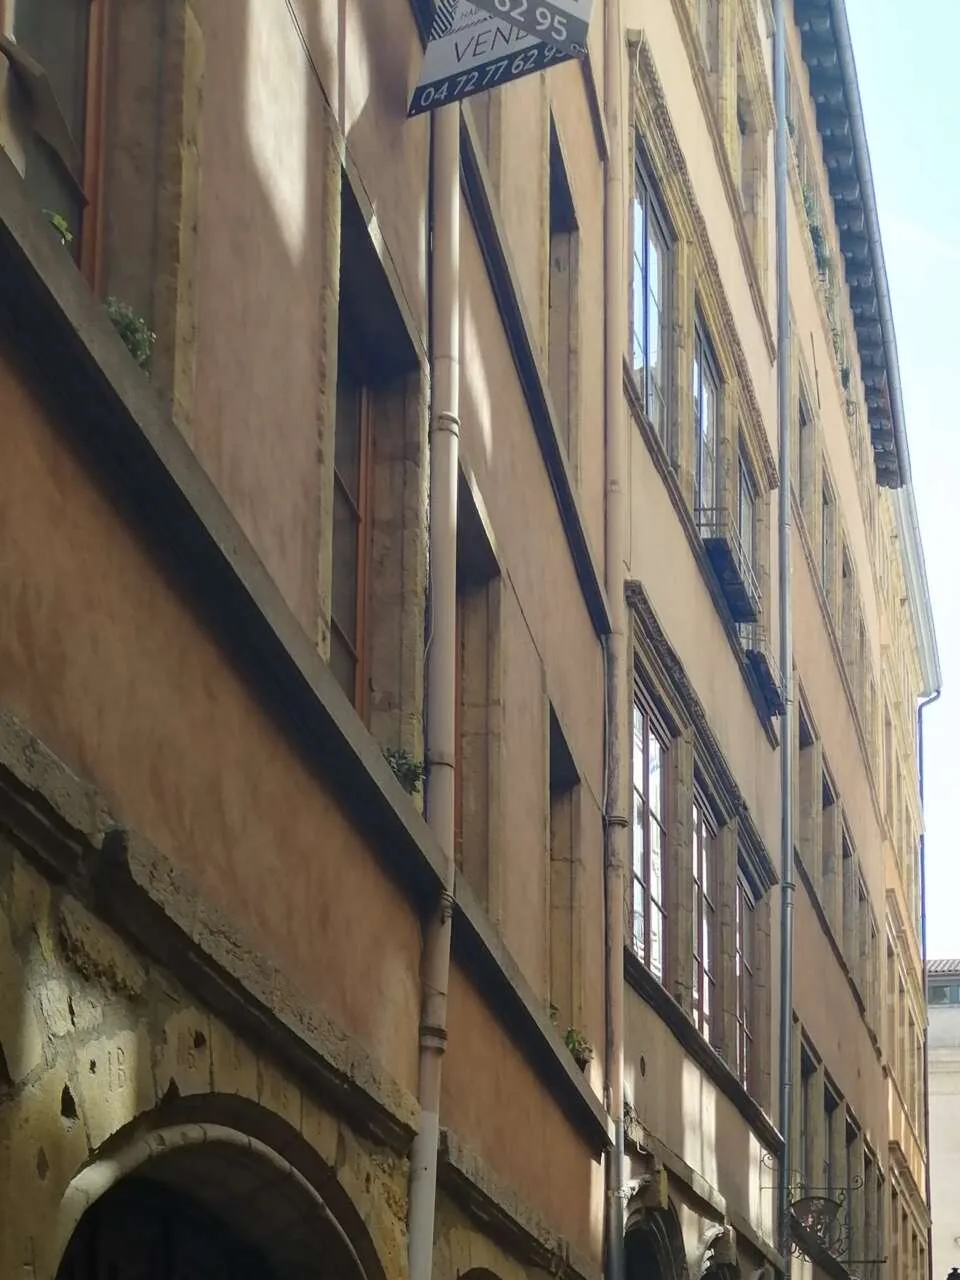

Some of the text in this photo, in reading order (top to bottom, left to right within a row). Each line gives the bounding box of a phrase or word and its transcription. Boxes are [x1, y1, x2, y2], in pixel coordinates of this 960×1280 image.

[535, 7, 567, 41] 95
[421, 82, 448, 107] 04
[453, 71, 478, 97] 72
[482, 60, 508, 86] 77
[511, 49, 539, 74] 62
